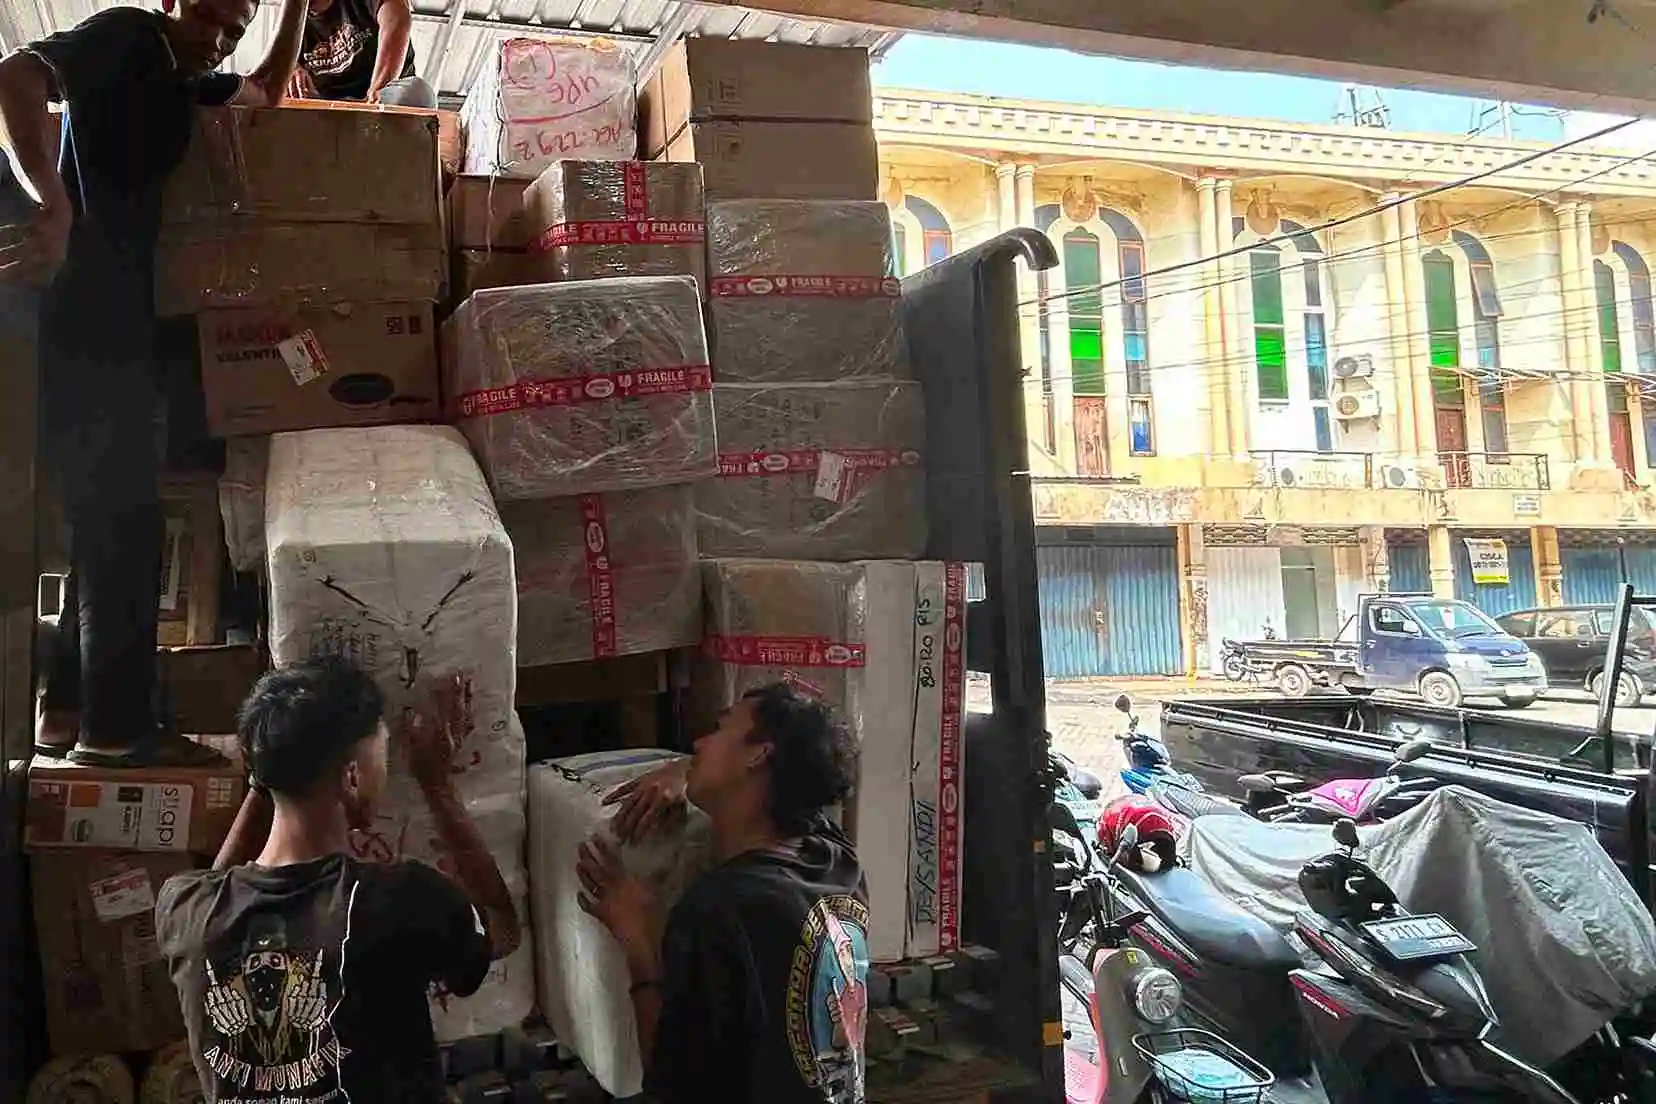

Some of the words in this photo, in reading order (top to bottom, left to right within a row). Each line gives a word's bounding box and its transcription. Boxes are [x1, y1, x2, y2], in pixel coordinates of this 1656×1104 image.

[651, 221, 705, 234] FRAGILE
[791, 277, 832, 288] FRAGILE
[637, 370, 685, 385] FRAGILE
[943, 714, 954, 763] FRAGILE
[941, 877, 952, 928] FRAGILE
[1302, 991, 1341, 1021] HONDA
[203, 1045, 252, 1088] ANTI
